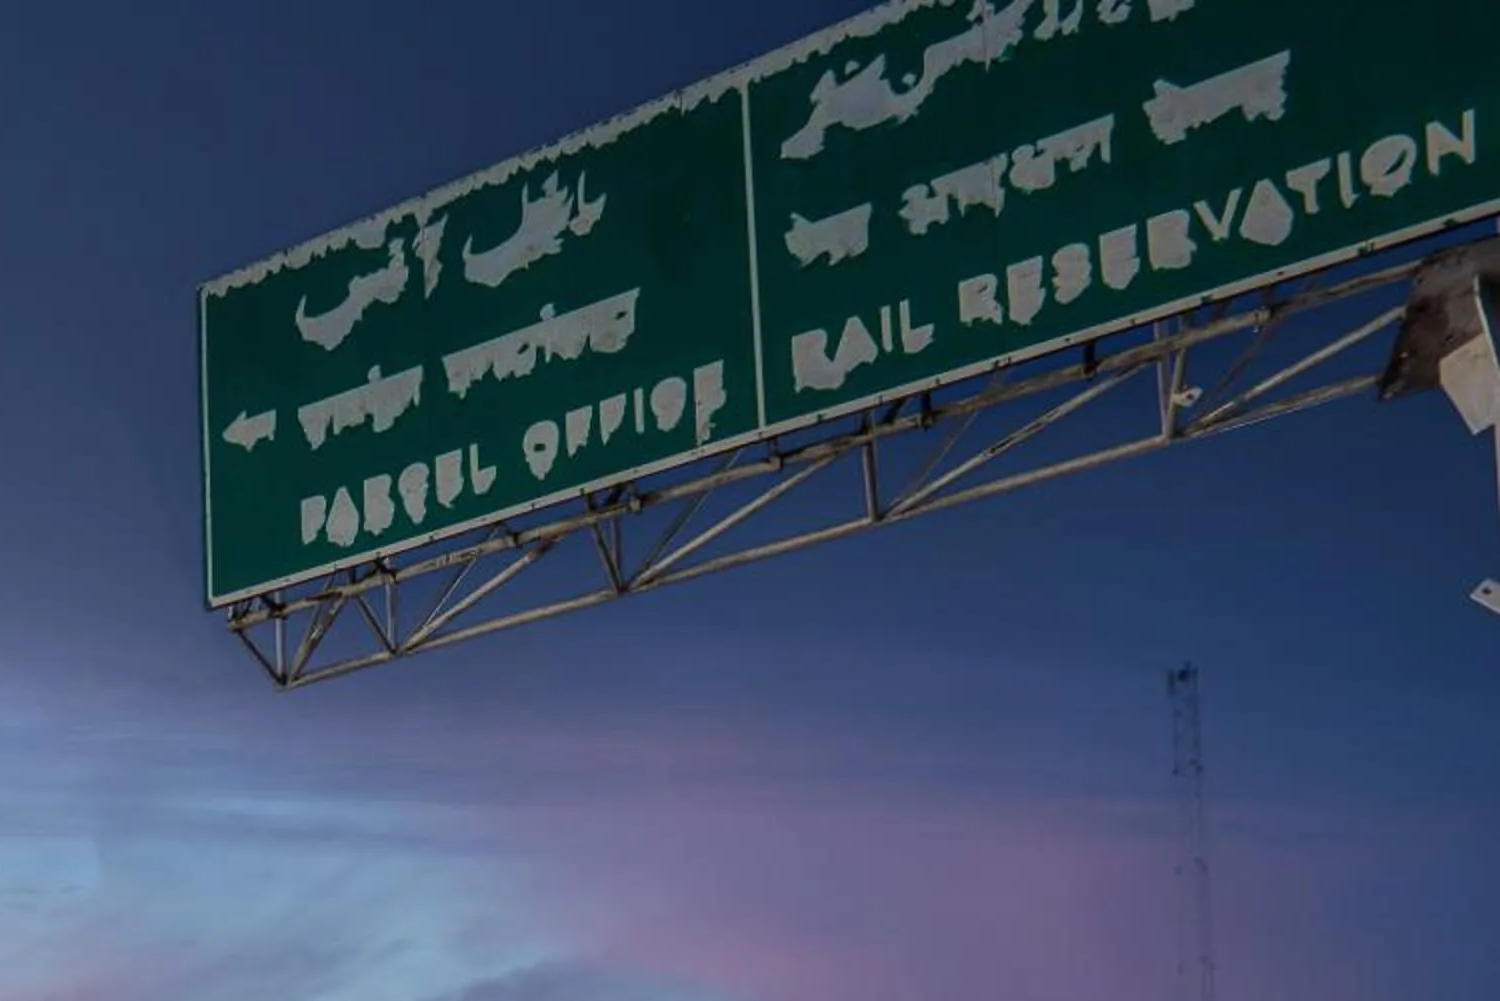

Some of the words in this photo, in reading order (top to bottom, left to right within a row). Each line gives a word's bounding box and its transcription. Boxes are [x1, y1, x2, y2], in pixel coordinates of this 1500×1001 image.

[792, 300, 935, 393] RAIL
[959, 108, 1476, 326] RESERVATION
[301, 444, 497, 547] PARCEL
